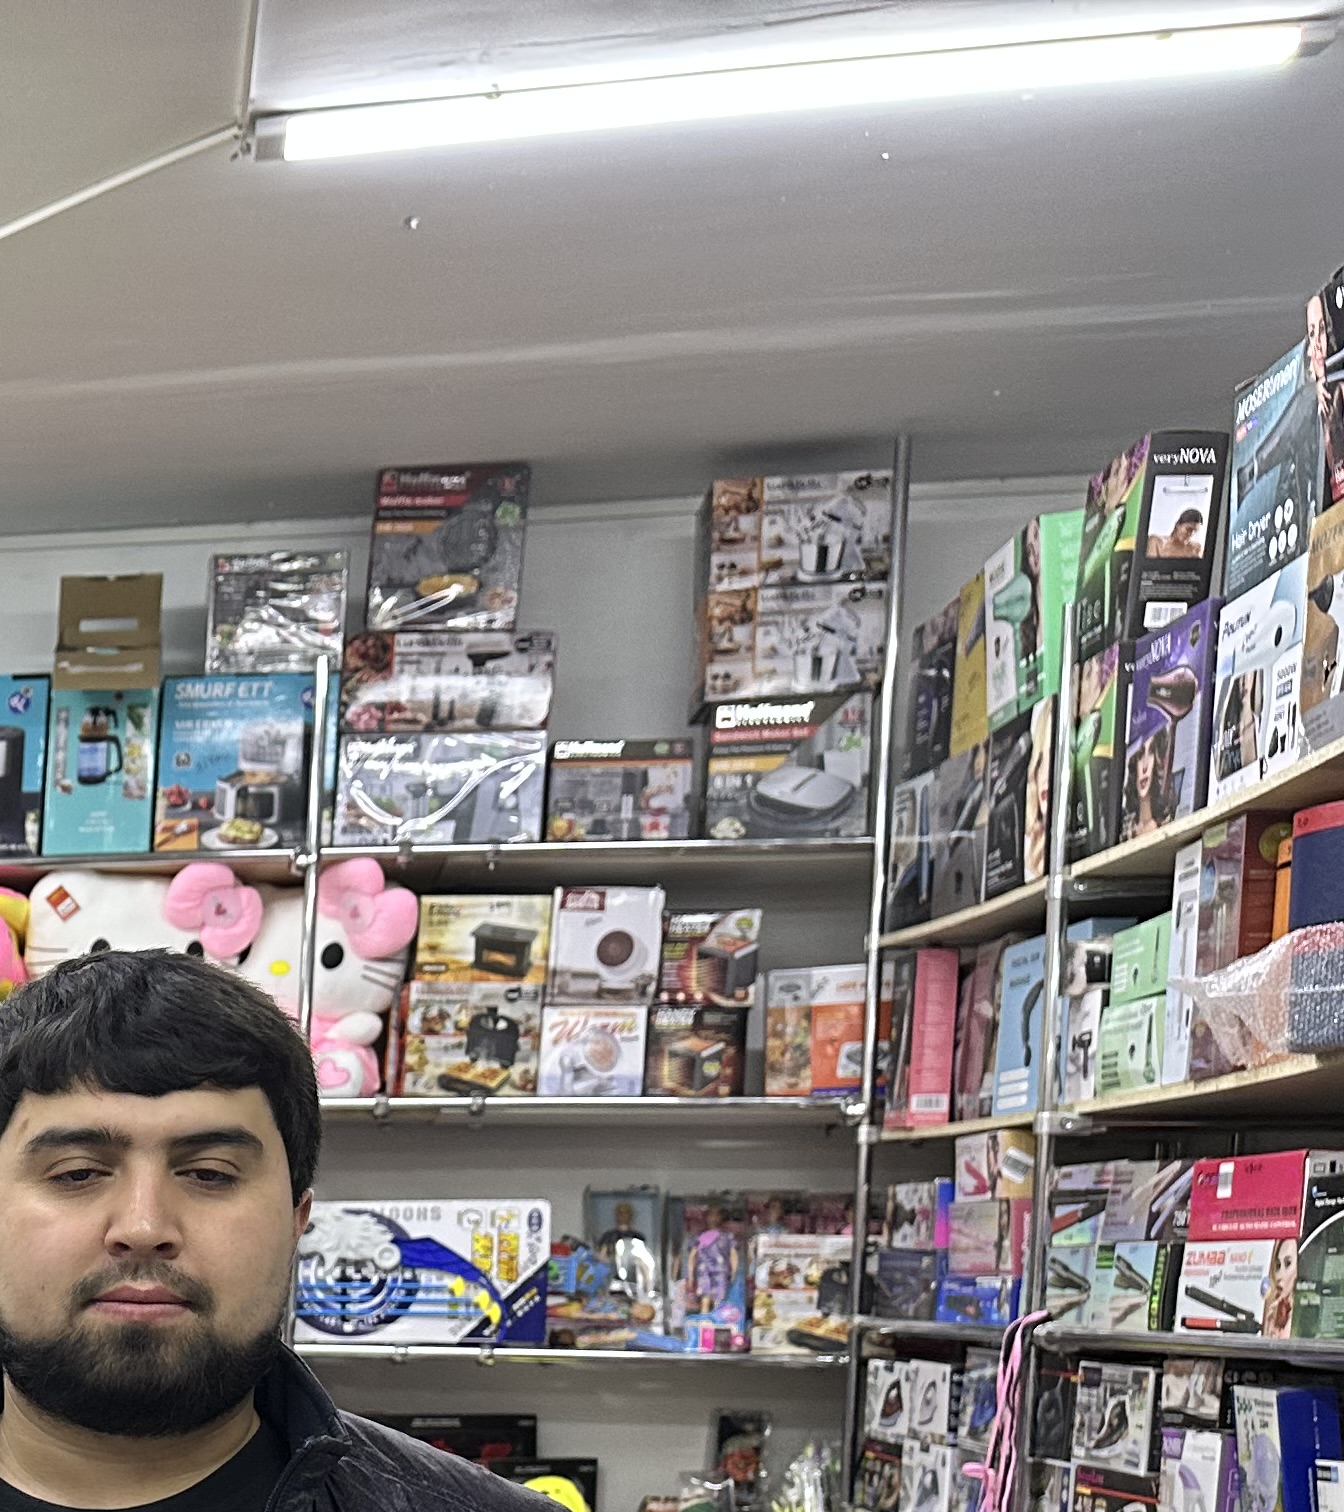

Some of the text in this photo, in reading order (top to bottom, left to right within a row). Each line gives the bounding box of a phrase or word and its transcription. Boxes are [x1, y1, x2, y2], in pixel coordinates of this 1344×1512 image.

[1153, 448, 1216, 465] veryNOVA
[1231, 511, 1272, 552] Hair Dryer
